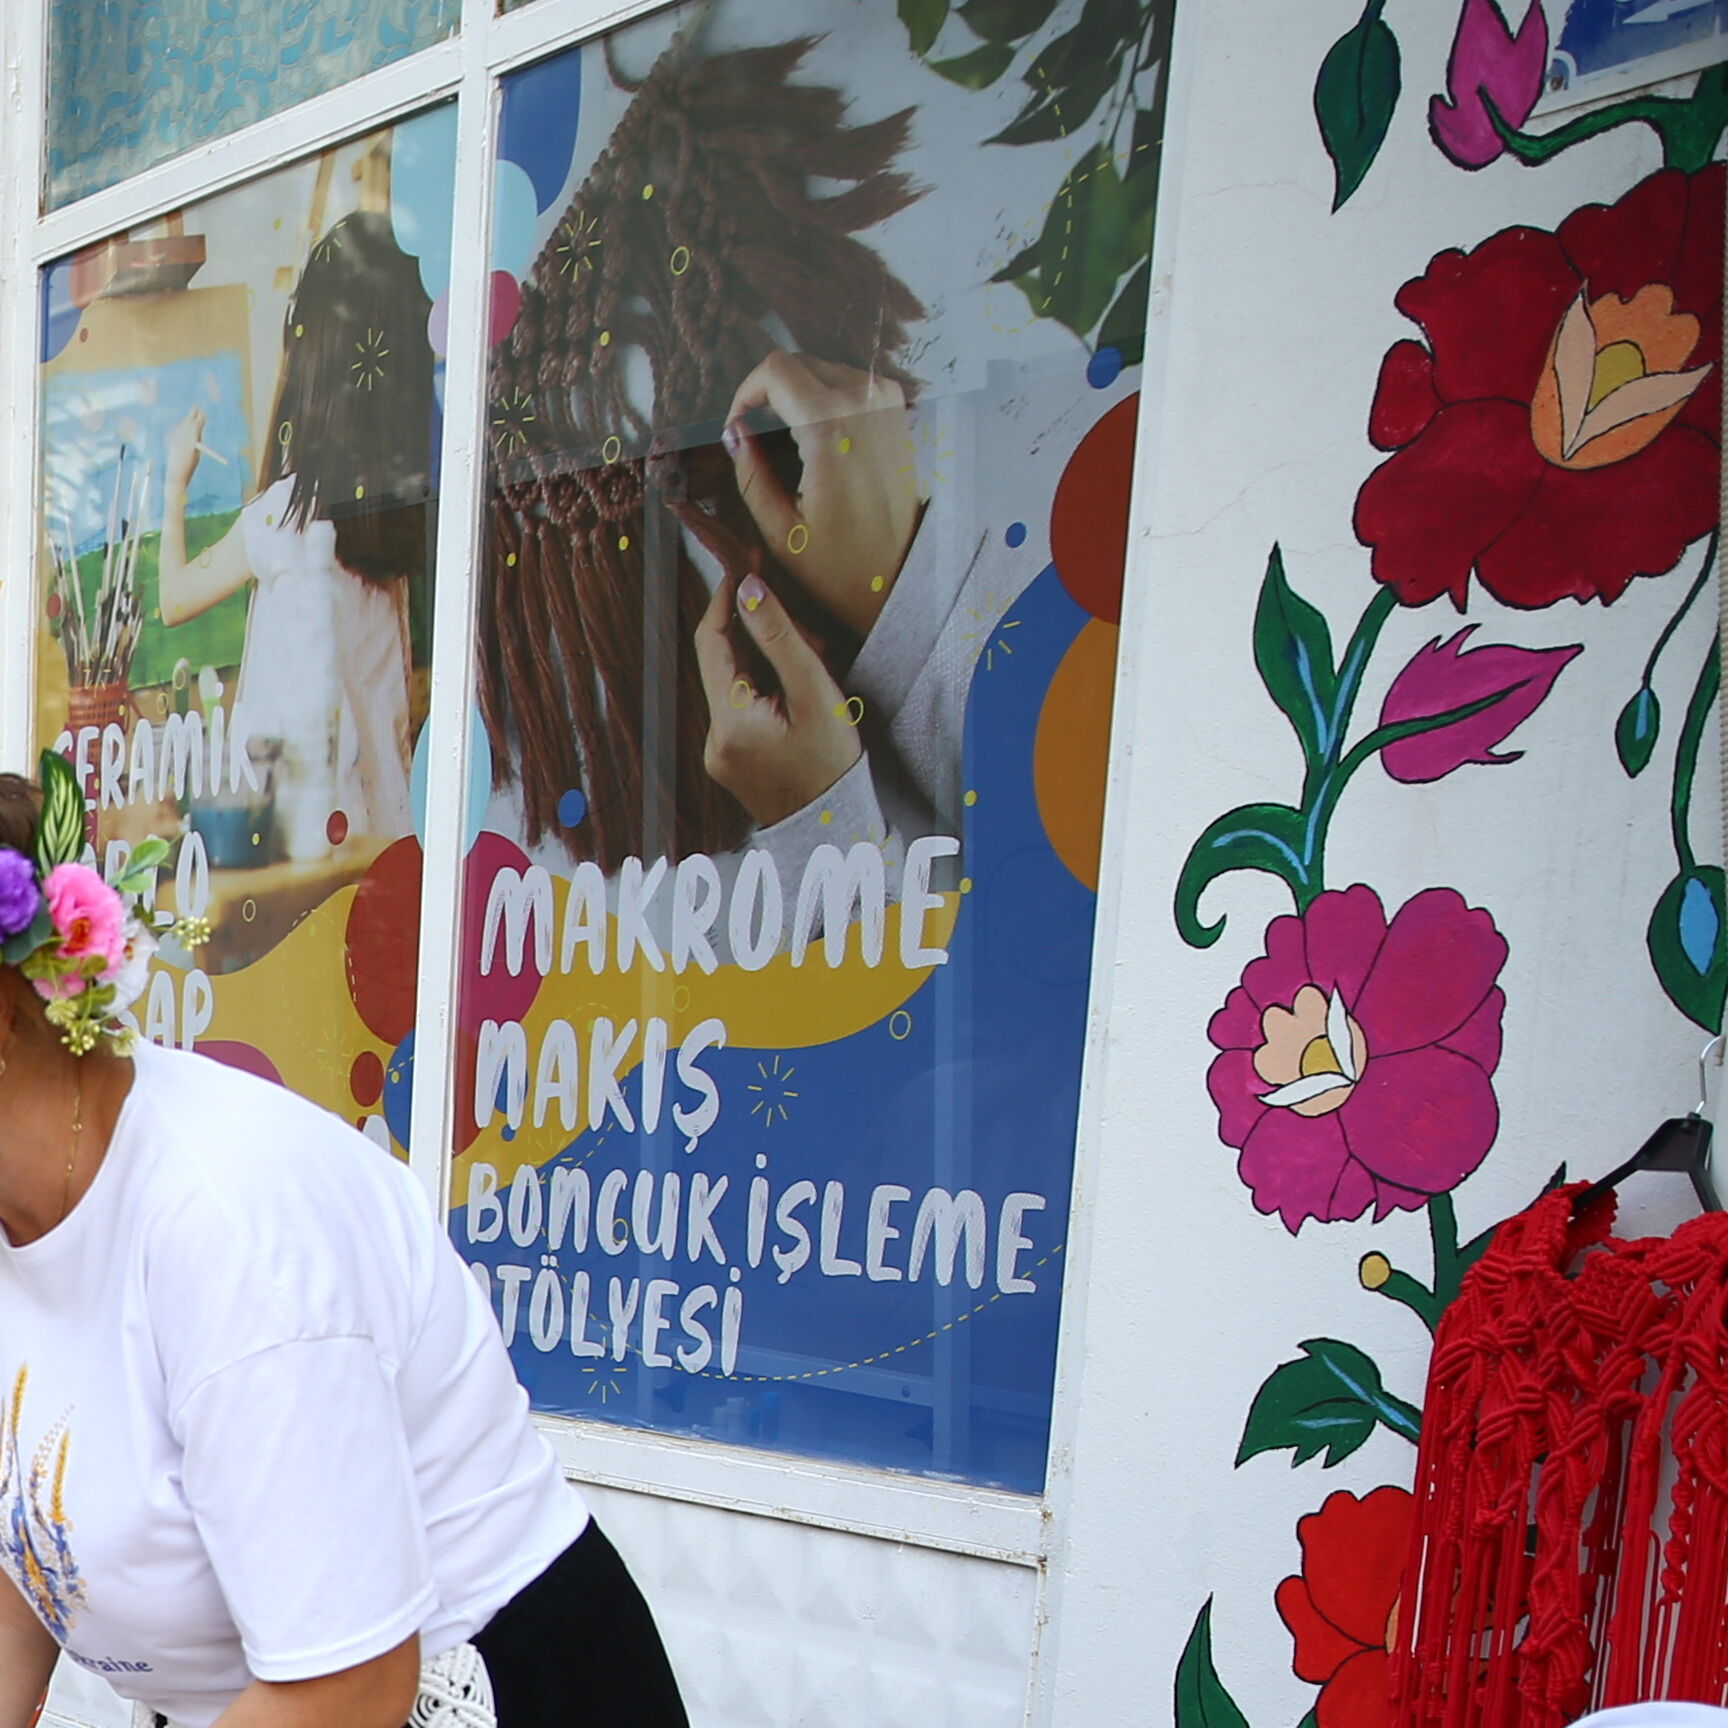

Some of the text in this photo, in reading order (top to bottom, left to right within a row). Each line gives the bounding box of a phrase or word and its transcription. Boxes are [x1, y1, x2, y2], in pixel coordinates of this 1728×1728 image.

[480, 836, 960, 976] MAKROME
[474, 1016, 727, 1154] NAKIŞ
[467, 1154, 1046, 1294] BONCUK İŞLEME
